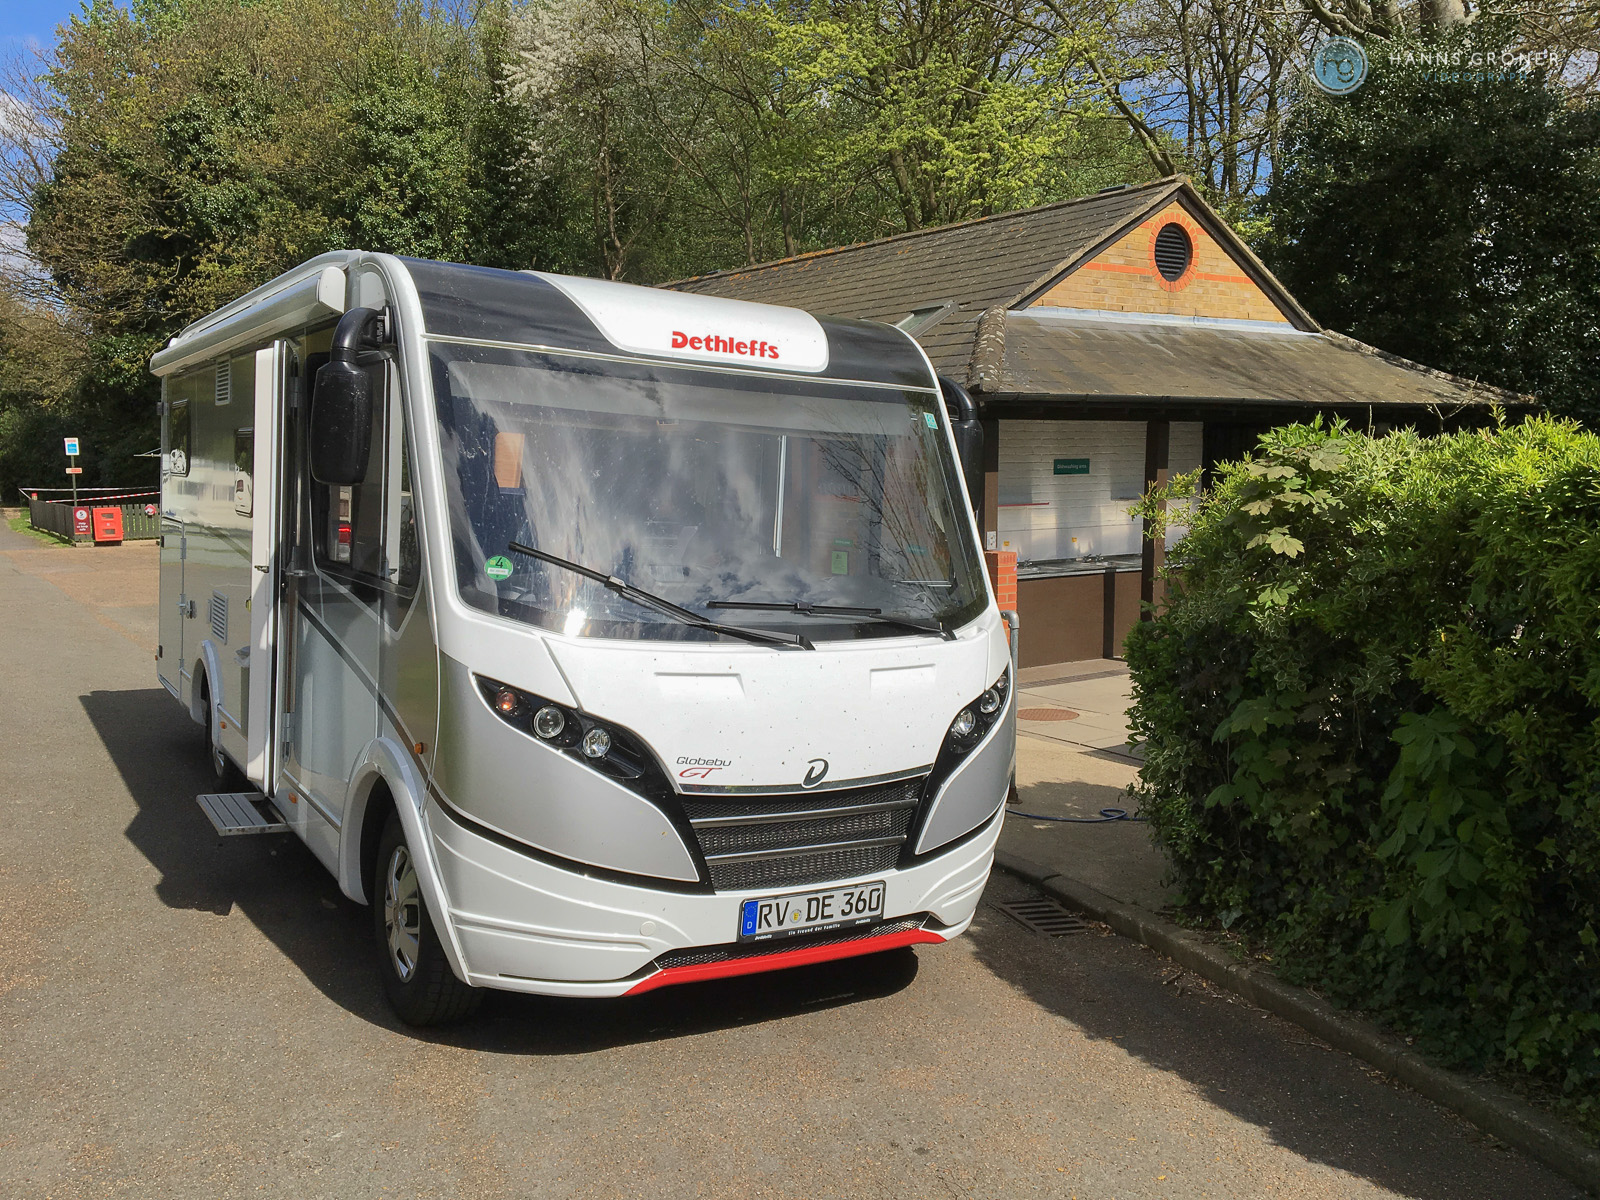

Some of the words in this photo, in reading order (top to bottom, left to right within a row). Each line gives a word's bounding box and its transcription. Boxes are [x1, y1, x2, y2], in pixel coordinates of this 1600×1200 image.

[671, 330, 780, 360] Dethleffs
[495, 556, 504, 569] 4
[679, 767, 723, 779] GT
[757, 901, 790, 930] RV
[805, 894, 835, 923] DE
[840, 887, 882, 917] 360
[746, 921, 753, 930] D
